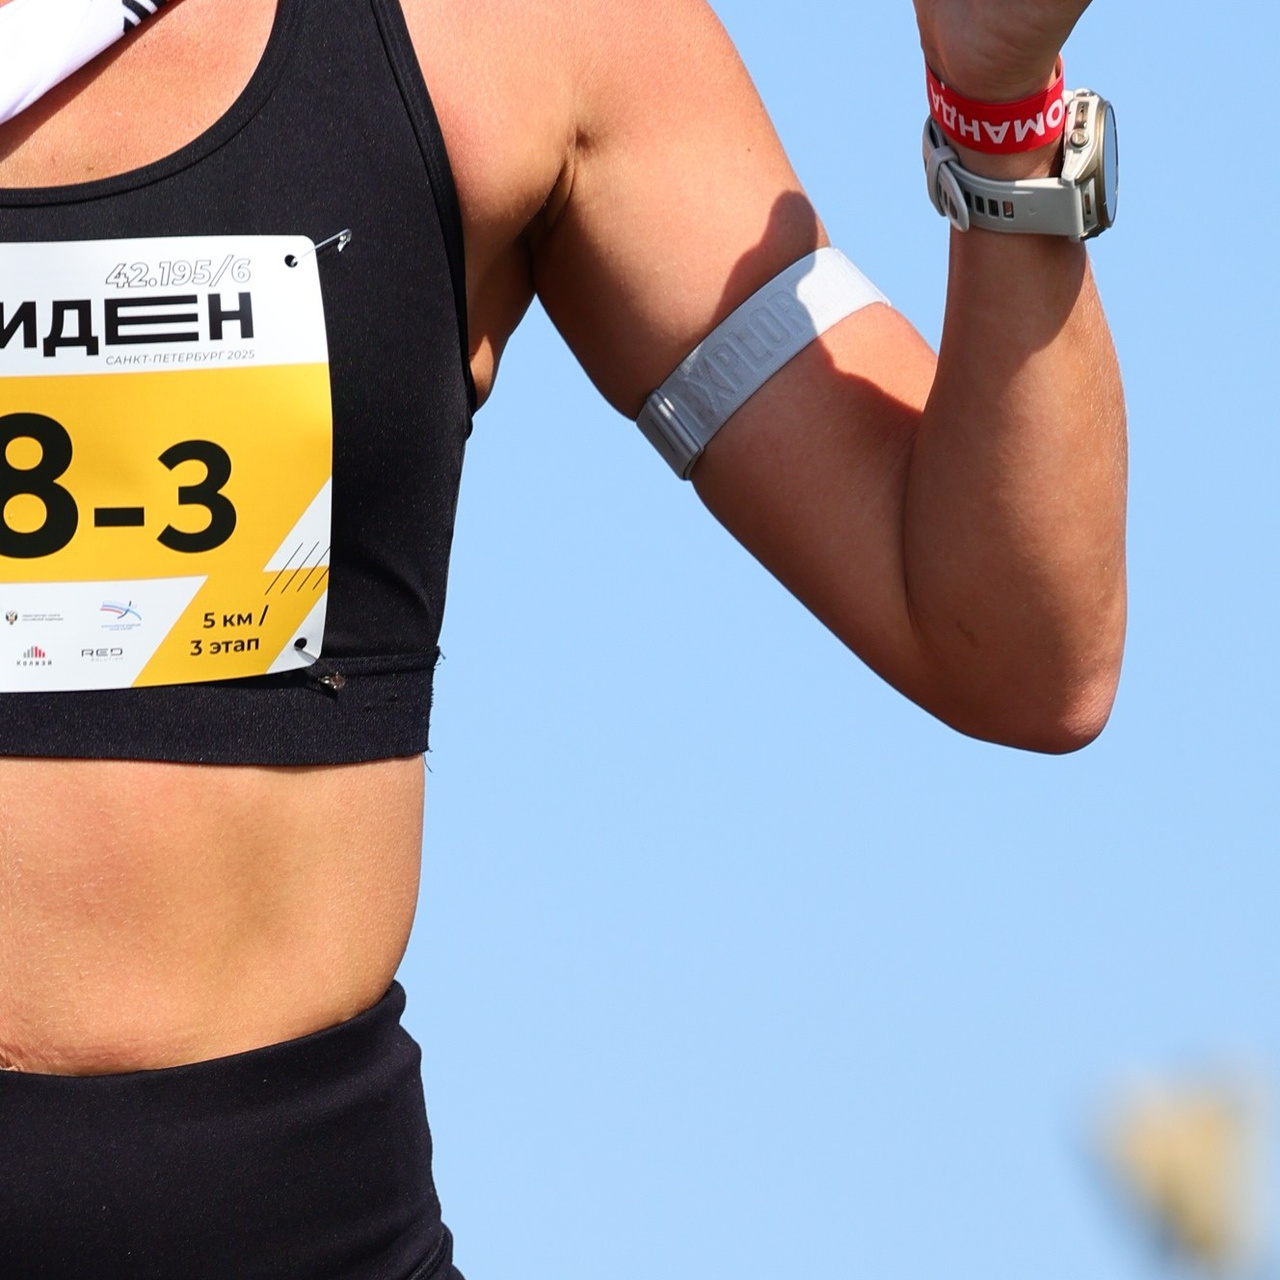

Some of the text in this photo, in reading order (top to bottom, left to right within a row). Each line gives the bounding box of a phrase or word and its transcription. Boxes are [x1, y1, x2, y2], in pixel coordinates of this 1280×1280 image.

[104, 254, 252, 289] 42.195/6
[105, 349, 256, 366] САНКТ-ПЕТЕРБУРГ 2025
[670, 282, 816, 429] XPLOR
[202, 612, 216, 629] 5
[222, 612, 253, 628] км
[189, 637, 260, 657] 3 этап
